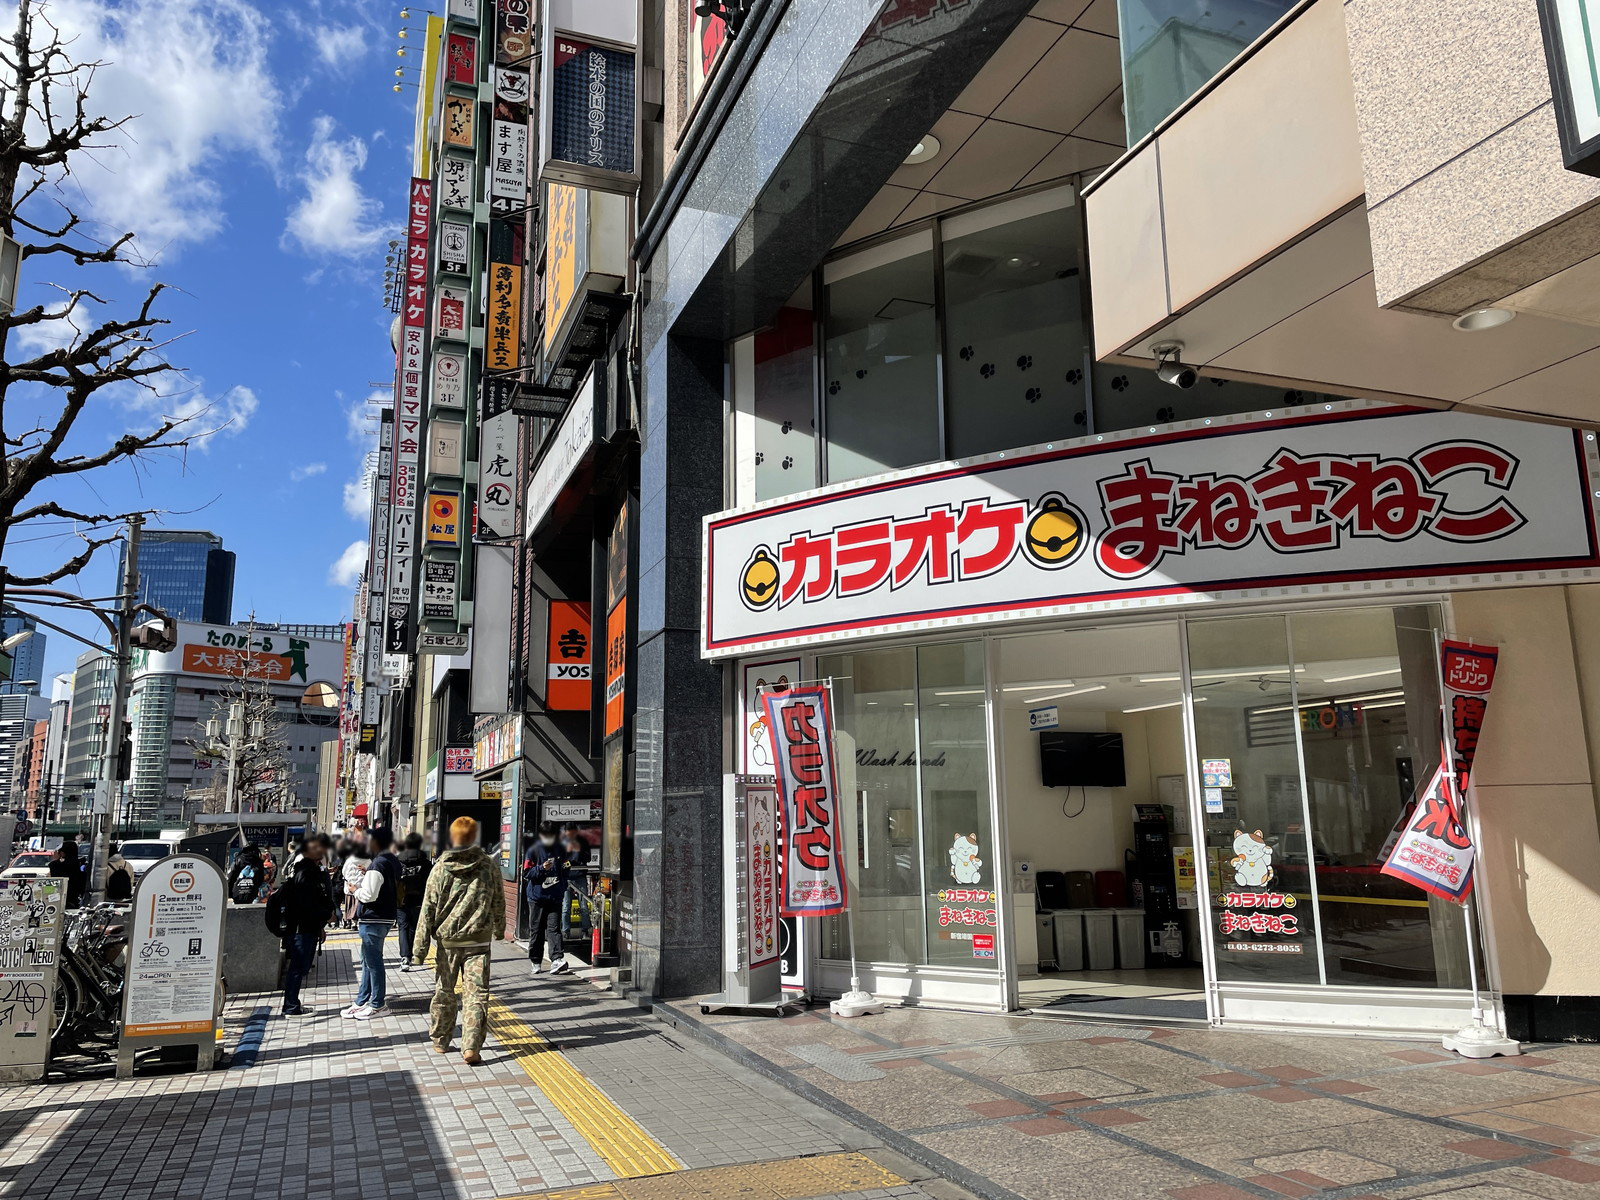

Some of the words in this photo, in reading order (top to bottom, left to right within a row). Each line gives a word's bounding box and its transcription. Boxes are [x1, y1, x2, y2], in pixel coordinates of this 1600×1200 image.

[560, 43, 577, 54] B2F
[588, 51, 607, 166] 絵本の国のアリス
[496, 125, 512, 174] ます屋
[495, 178, 522, 187] MASUYA
[492, 199, 525, 212] 4F
[446, 262, 461, 272] 5F
[440, 394, 455, 402] 3F
[397, 465, 408, 507] 300名
[407, 466, 416, 507] 地域最大級
[484, 454, 512, 506] 虎丸
[431, 523, 455, 535] 松屋
[481, 526, 492, 535] 2F
[778, 499, 1030, 609] カラオケ
[1095, 440, 1527, 579] まねきねこ
[395, 514, 412, 582] パーティー
[392, 587, 410, 595] 貸切
[426, 583, 454, 595] 牛かつ
[207, 629, 273, 652] たのめーる
[393, 619, 405, 651] ダーツ
[424, 635, 465, 646] 石塚ビル
[558, 629, 587, 658] 吉
[192, 652, 284, 675] 大塚商会
[1454, 657, 1480, 672] フード
[1449, 670, 1488, 686] ドリンク
[1299, 704, 1364, 731] FRONT
[855, 748, 897, 768] Wash
[545, 804, 586, 816] Tokaien
[752, 842, 764, 957] まねきねこ
[763, 858, 773, 935] カラオケ
[945, 889, 990, 903] カラオケ
[1226, 892, 1285, 908] カラオケ
[938, 905, 997, 927] まねきねこ
[1218, 911, 1300, 935] まねきねこ
[1163, 920, 1182, 958] 充電
[1236, 943, 1300, 953] 03-6273-8055
